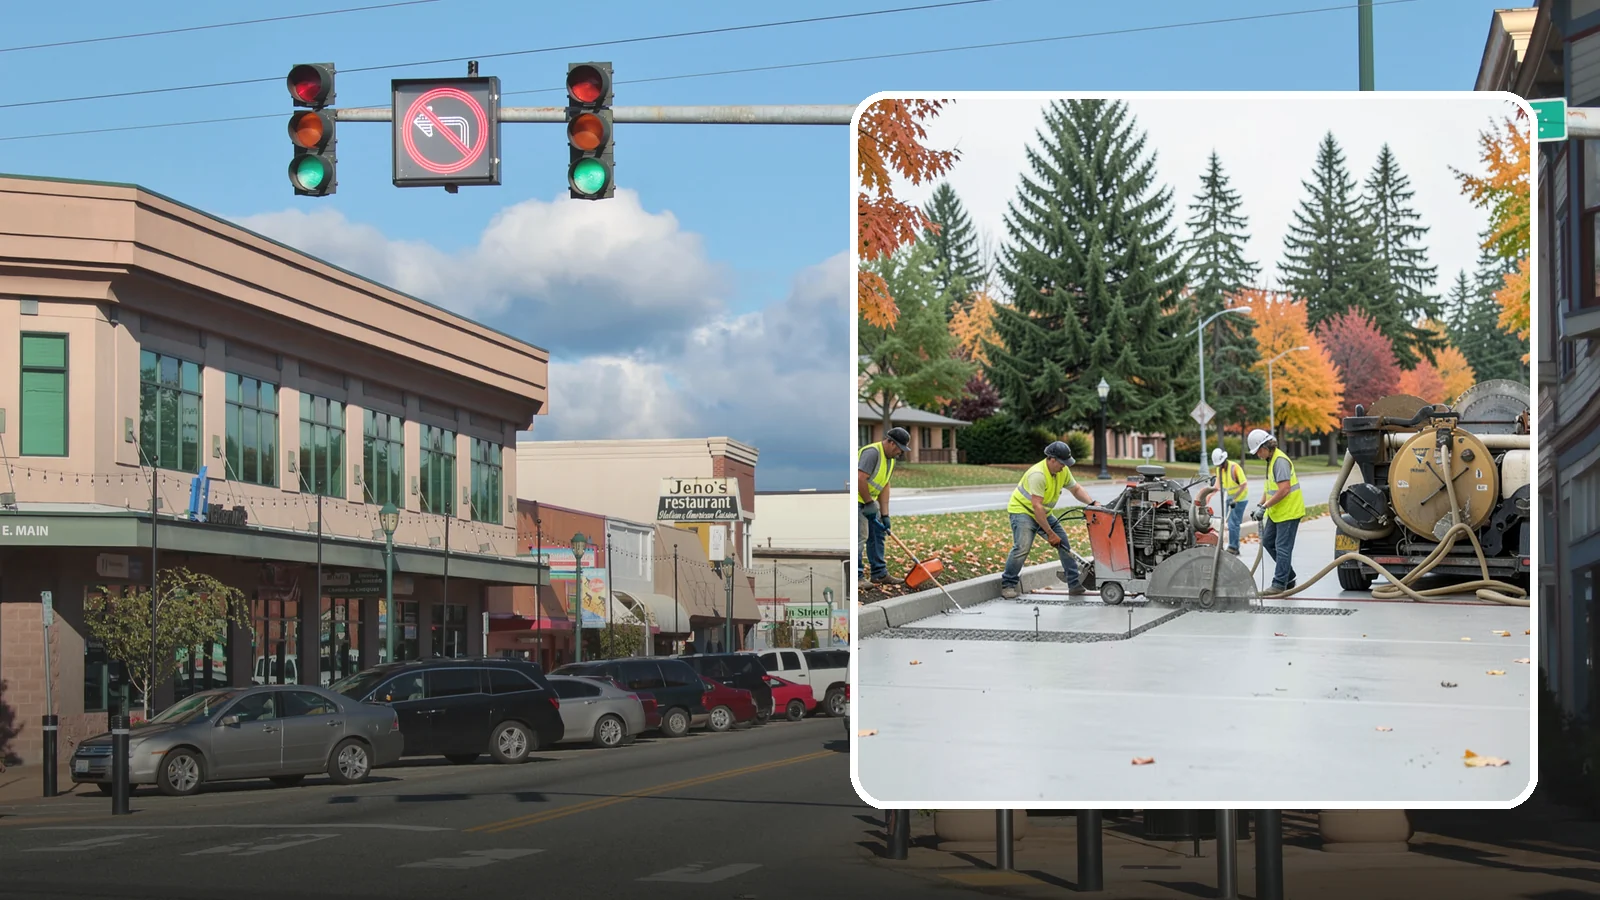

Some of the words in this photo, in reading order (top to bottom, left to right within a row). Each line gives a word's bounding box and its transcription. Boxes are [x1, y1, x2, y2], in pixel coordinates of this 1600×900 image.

[669, 480, 728, 495] Jeno's
[665, 496, 731, 509] restaurant
[658, 510, 681, 519] Italian
[686, 510, 714, 519] American
[715, 509, 737, 519] Cuisine
[2, 525, 13, 536] E.
[15, 525, 49, 536] MAIN
[797, 608, 829, 616] Street
